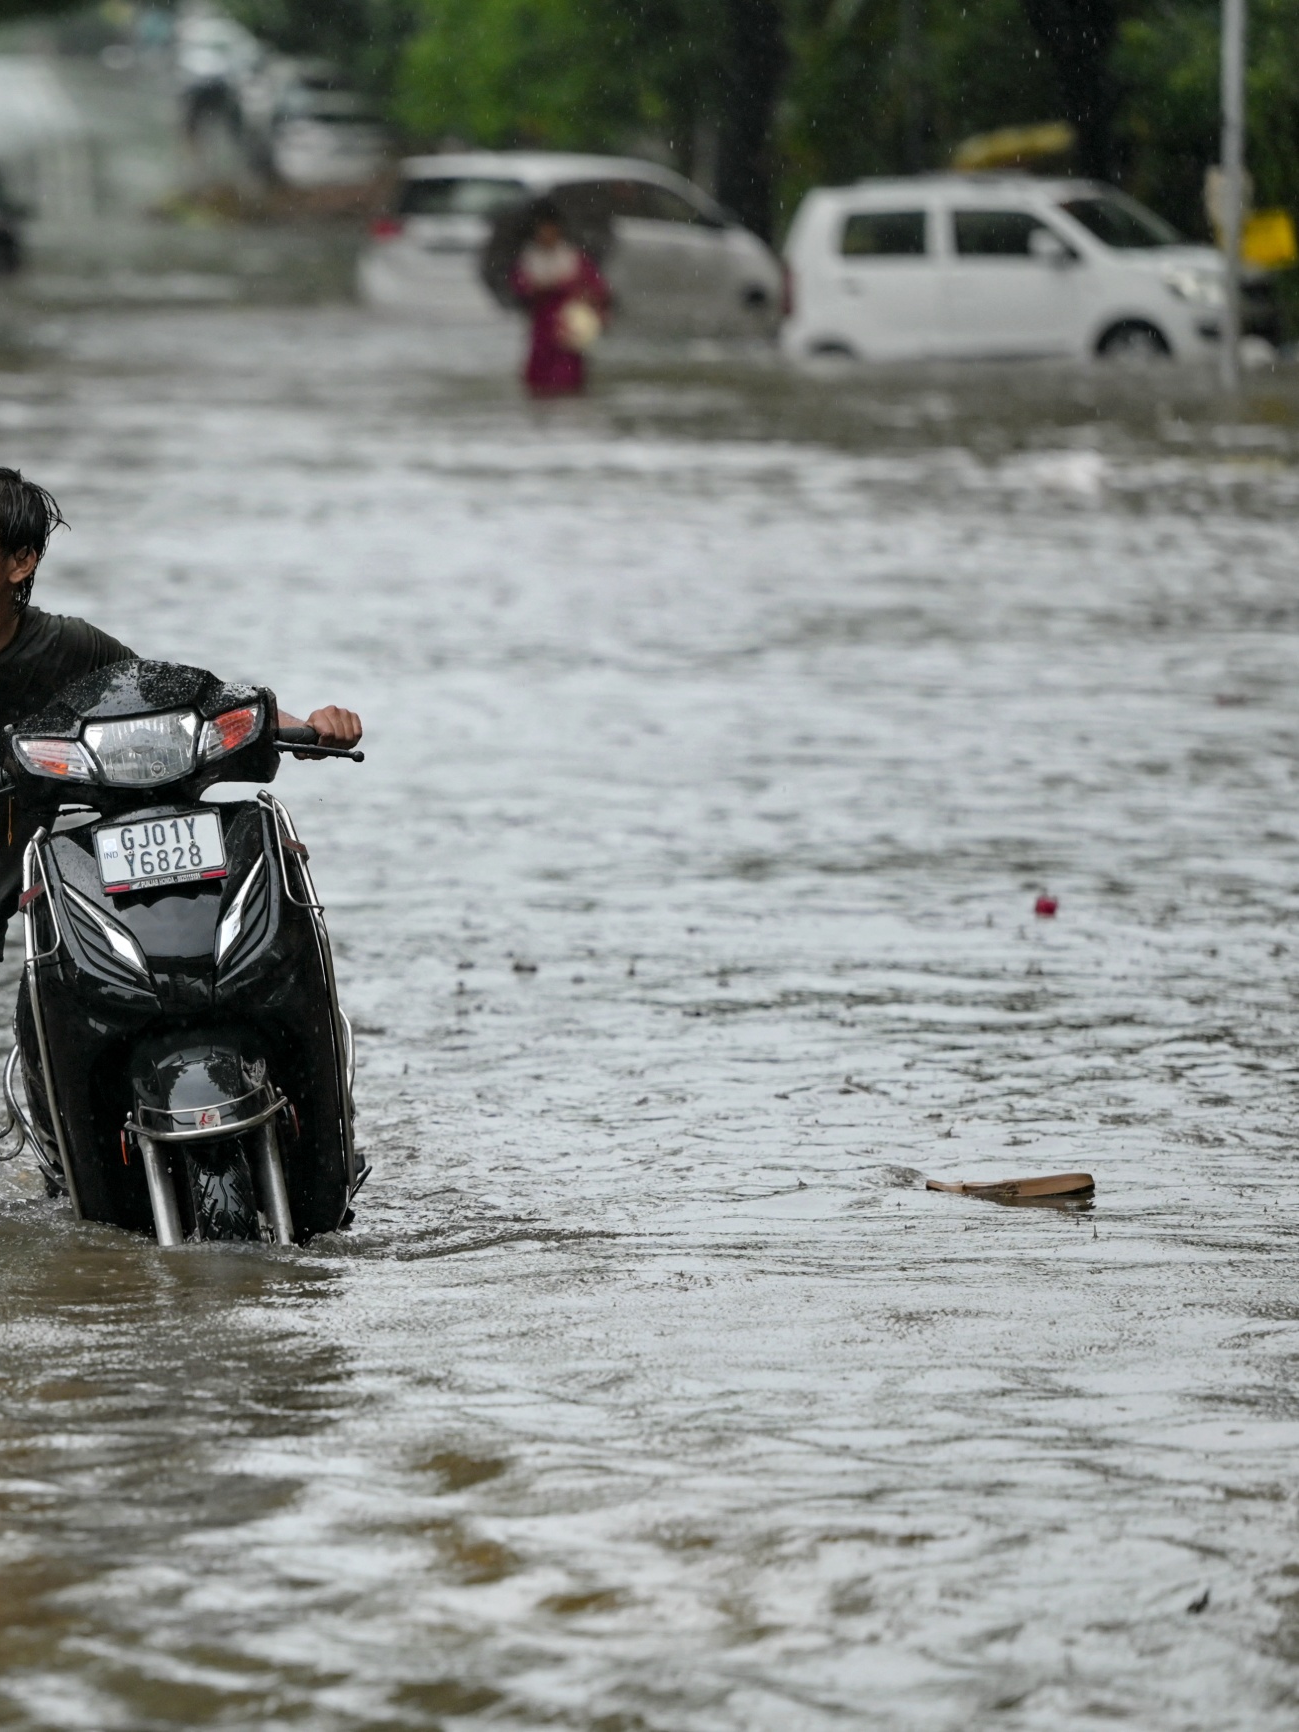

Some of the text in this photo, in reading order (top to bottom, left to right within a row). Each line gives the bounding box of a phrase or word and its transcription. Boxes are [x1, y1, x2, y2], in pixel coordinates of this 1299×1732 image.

[121, 817, 195, 850] GJ01Y
[103, 851, 118, 859] IND
[124, 844, 202, 877] Y6828
